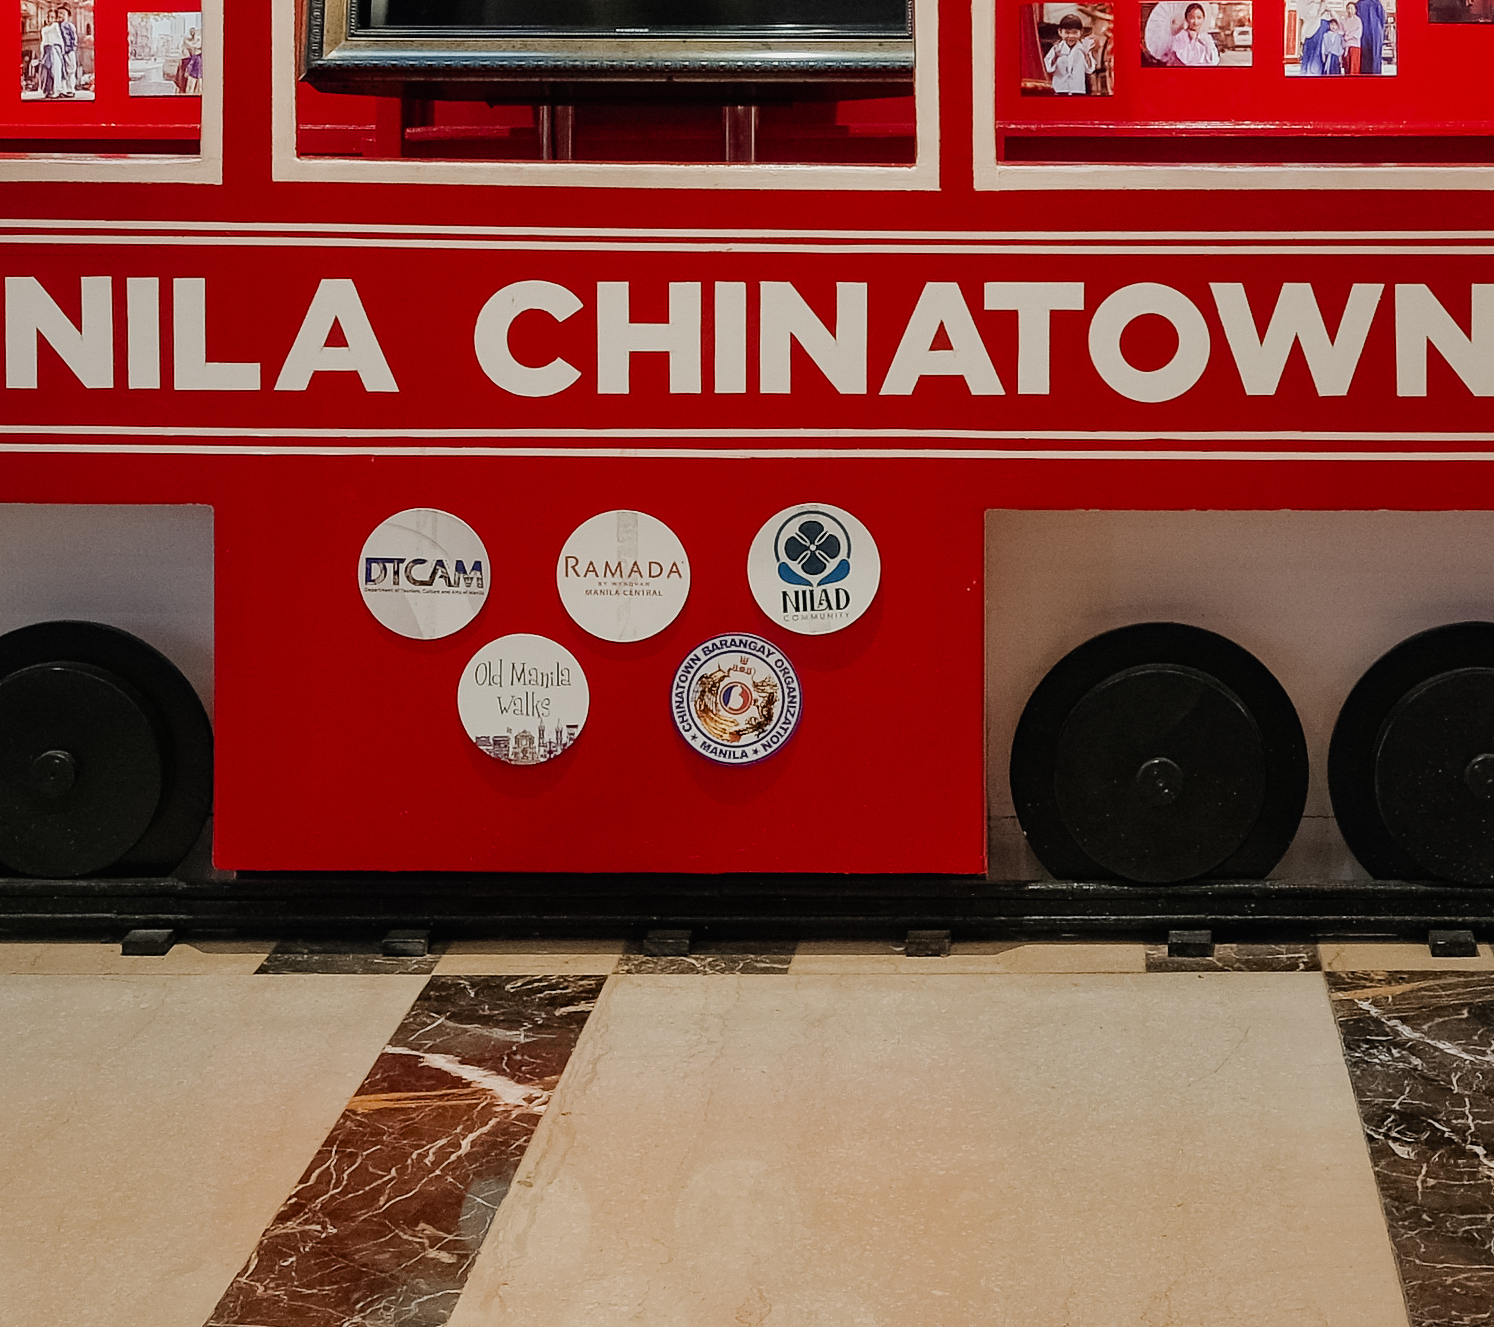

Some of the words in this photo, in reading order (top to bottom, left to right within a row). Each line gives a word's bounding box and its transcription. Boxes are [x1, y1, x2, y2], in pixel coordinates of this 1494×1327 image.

[365, 557, 484, 588] DTCAM
[564, 555, 682, 579] RAMADA
[782, 587, 851, 613] NILAD
[783, 612, 850, 622] COMMUNITY
[474, 659, 503, 687] Old
[510, 661, 572, 689] Manila
[674, 653, 702, 733] CHINATOWN
[701, 638, 776, 659] BARANGAY
[760, 658, 798, 752] ORGANIZATION
[700, 740, 749, 760] MANILA
